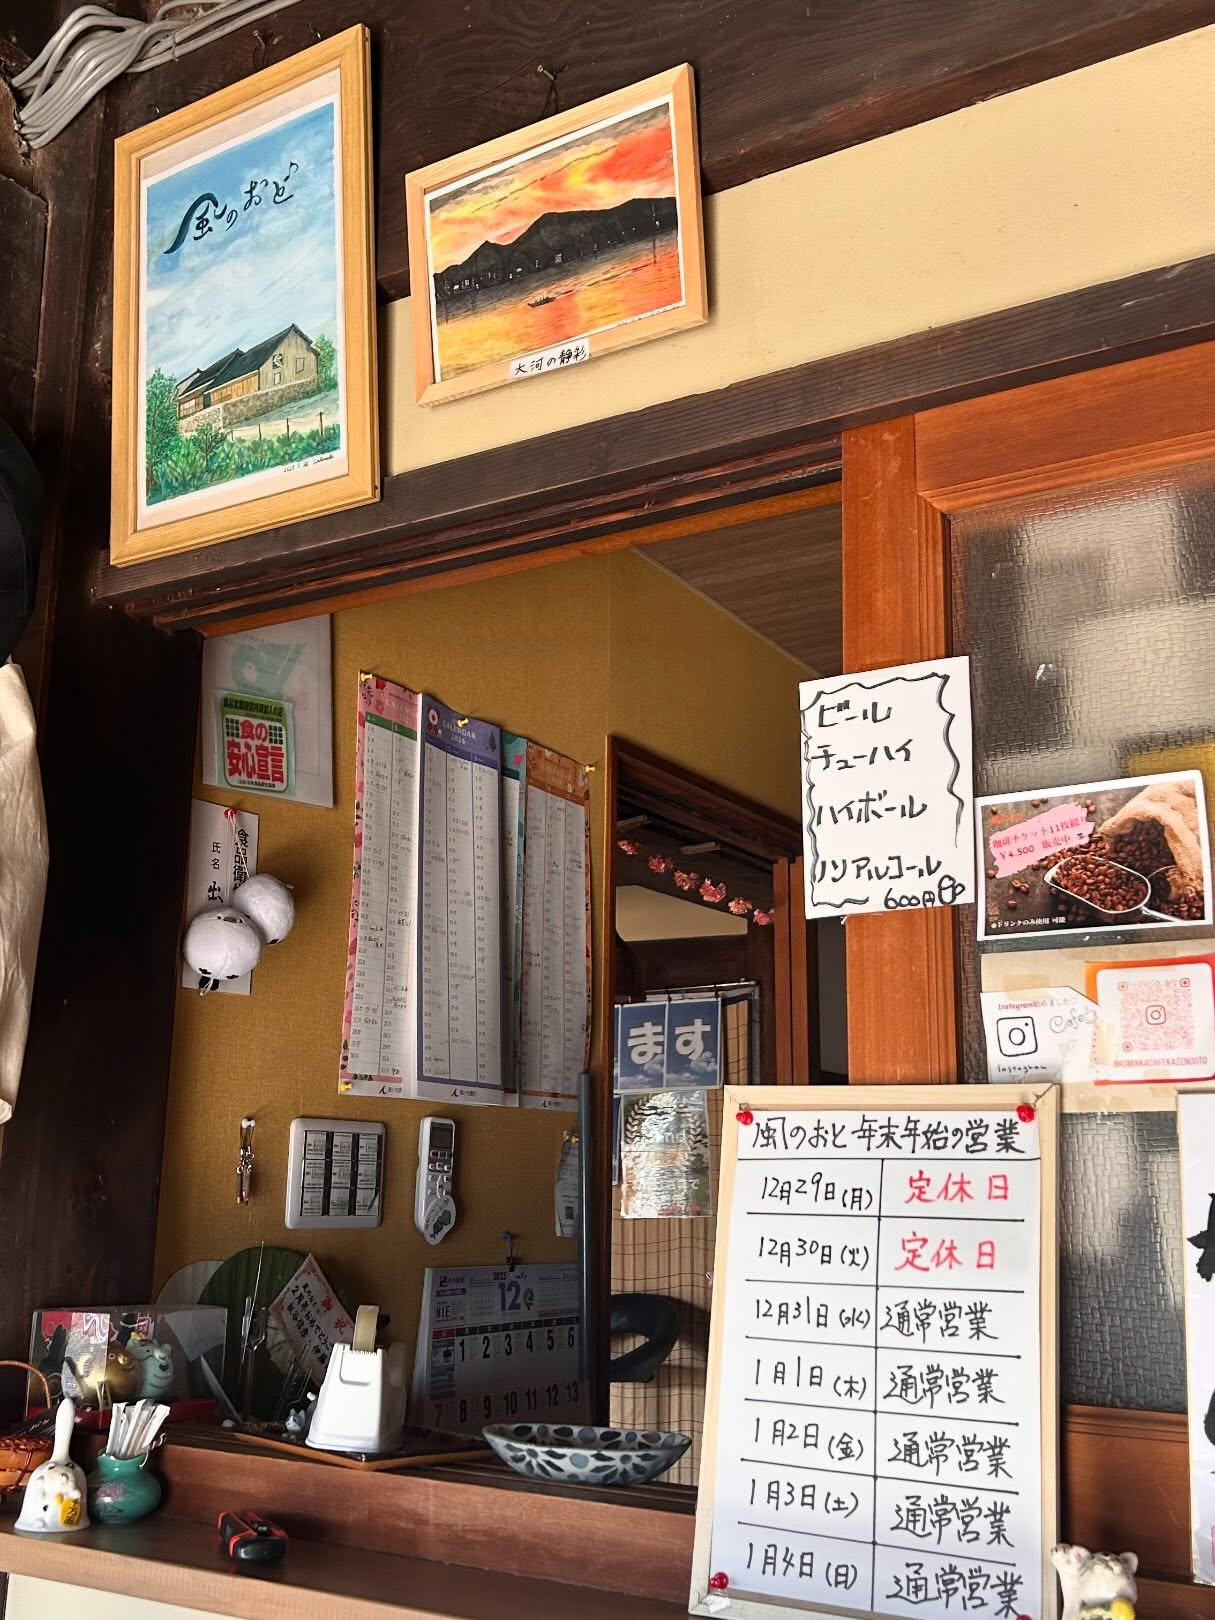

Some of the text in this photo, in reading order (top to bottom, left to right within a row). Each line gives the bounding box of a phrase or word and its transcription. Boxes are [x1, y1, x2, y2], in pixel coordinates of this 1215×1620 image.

[240, 719, 268, 743] 食の
[442, 719, 477, 740] CALENDAR
[818, 699, 892, 728] ビール
[226, 739, 285, 783] 安心宣言
[811, 738, 913, 771] チューハイ
[816, 789, 928, 827] ハイボール
[211, 841, 222, 870] 氏名
[232, 828, 249, 891] 食品衛
[1041, 834, 1071, 849] 販売中
[817, 855, 942, 883] ノンアルコール
[884, 887, 936, 909] 600円
[628, 1018, 711, 1065] ます
[752, 1114, 1025, 1154] 風のおと 年末年始の営業
[905, 1170, 1009, 1204] 定休日
[894, 1231, 996, 1271] 定休日
[498, 1280, 522, 1312] 12
[880, 1298, 999, 1343] 通常営業
[459, 1326, 575, 1362] 1 2 3 4 5 6
[433, 1403, 443, 1427] 7
[459, 1399, 468, 1423] 8
[483, 1395, 492, 1419] 9
[503, 1391, 518, 1415] 10
[526, 1387, 538, 1410] 11
[546, 1383, 559, 1406] 12
[883, 1364, 1005, 1408] 通常営業
[888, 1431, 1012, 1478] 通常営業
[891, 1494, 1014, 1547] 通常営業
[886, 1563, 1023, 1617] 通常営業
